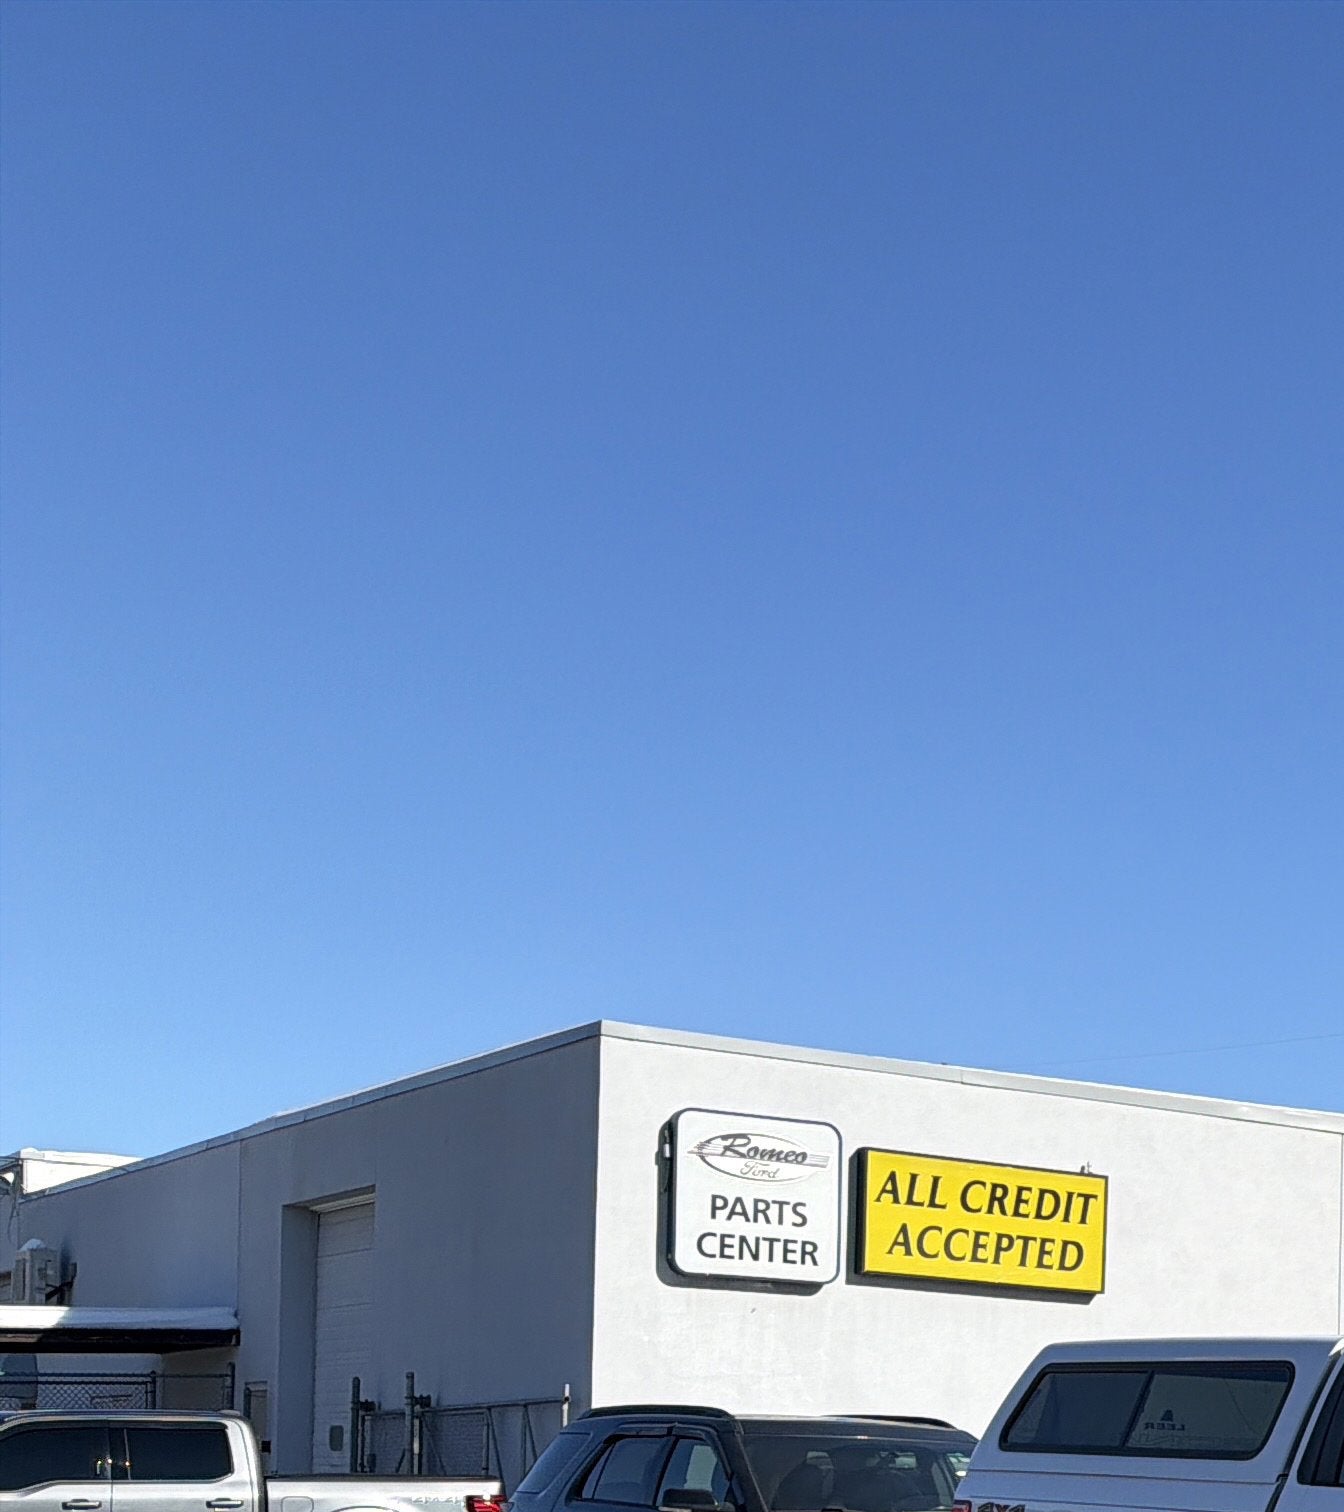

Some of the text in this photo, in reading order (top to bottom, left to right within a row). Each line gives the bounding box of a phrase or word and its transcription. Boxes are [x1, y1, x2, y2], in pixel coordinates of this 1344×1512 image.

[720, 1133, 808, 1164] Romeo
[740, 1162, 781, 1179] Ford
[710, 1194, 809, 1227] PARTS
[875, 1170, 1098, 1226] ALL CREDIT
[696, 1231, 819, 1266] CENTER
[886, 1222, 1085, 1272] ACCEPTED
